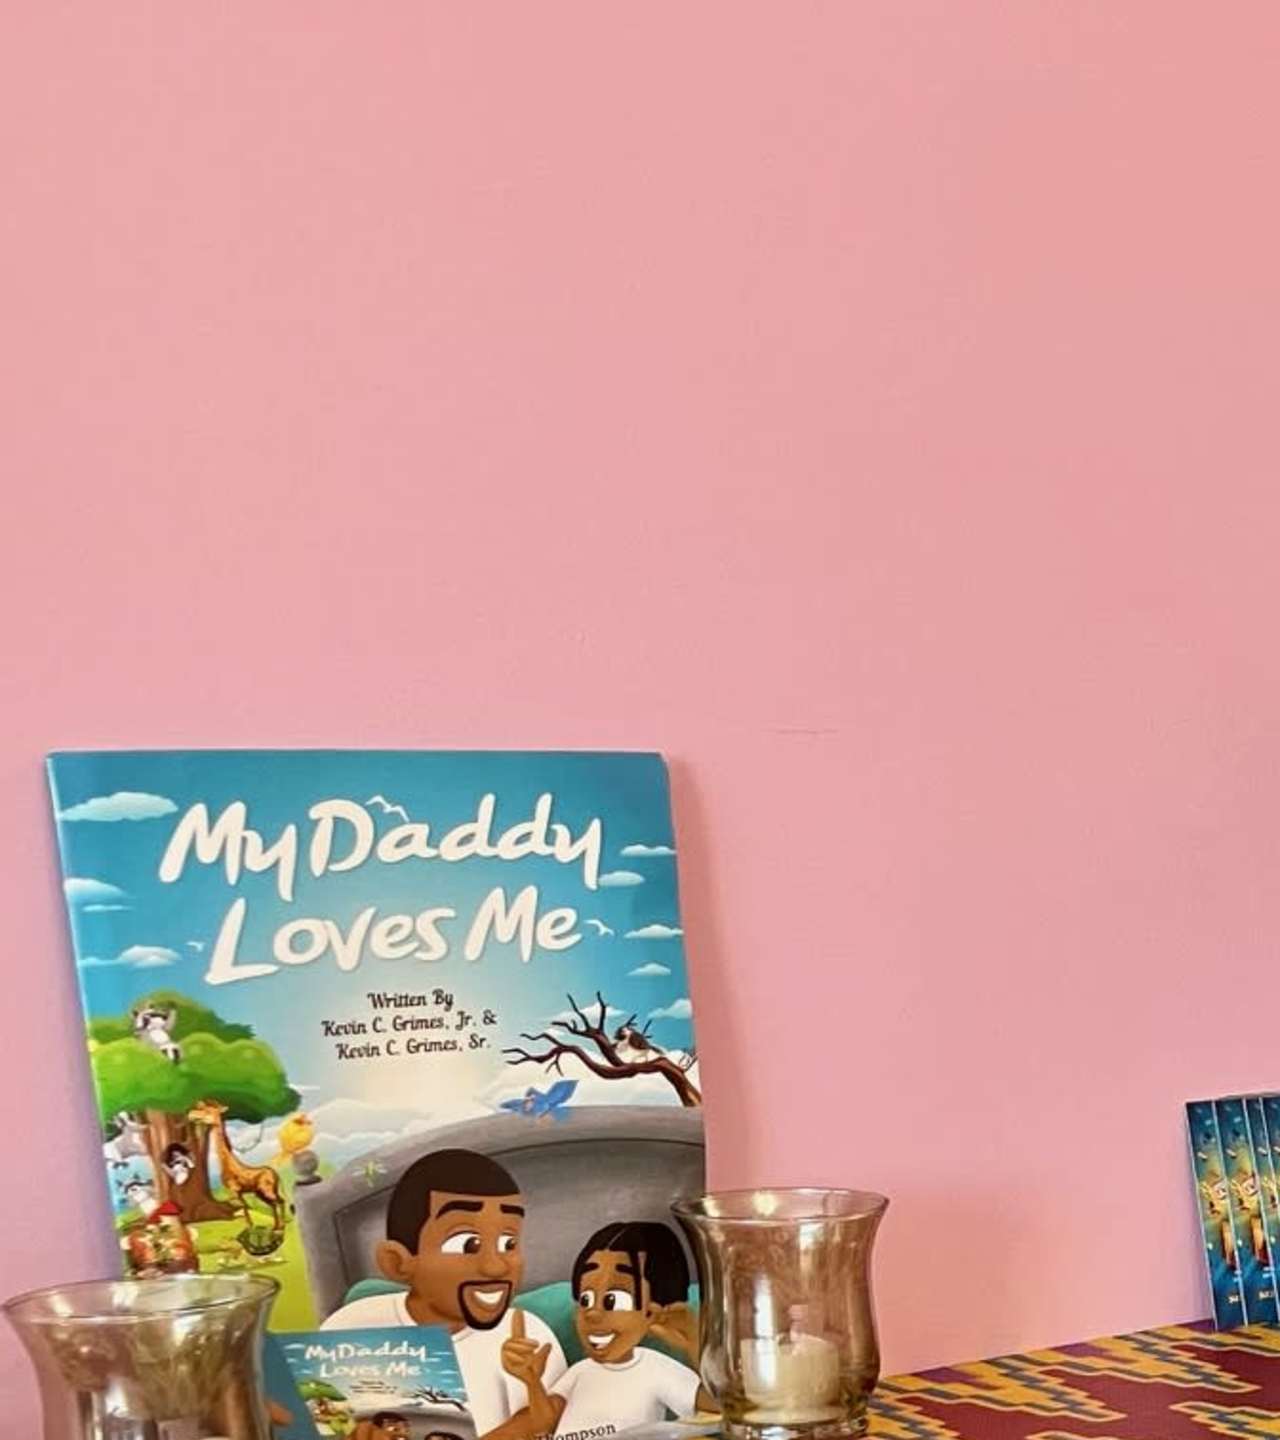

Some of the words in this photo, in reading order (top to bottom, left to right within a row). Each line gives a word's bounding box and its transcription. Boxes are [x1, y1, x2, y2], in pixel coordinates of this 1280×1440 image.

[159, 800, 297, 901] My
[309, 792, 602, 890] Daddy
[203, 897, 456, 986] Loves
[464, 884, 583, 963] Me
[367, 991, 428, 1010] Written
[432, 988, 454, 1011] By
[321, 1020, 367, 1037] Kevin
[372, 1016, 387, 1033] C.
[392, 1014, 450, 1032] Grimes,
[455, 1010, 477, 1031] Jr.
[482, 1009, 498, 1026] &
[335, 1043, 380, 1060] Kevin
[406, 1037, 463, 1055] Grimes,
[468, 1033, 491, 1050] Sr.
[337, 1340, 426, 1362] Daddy
